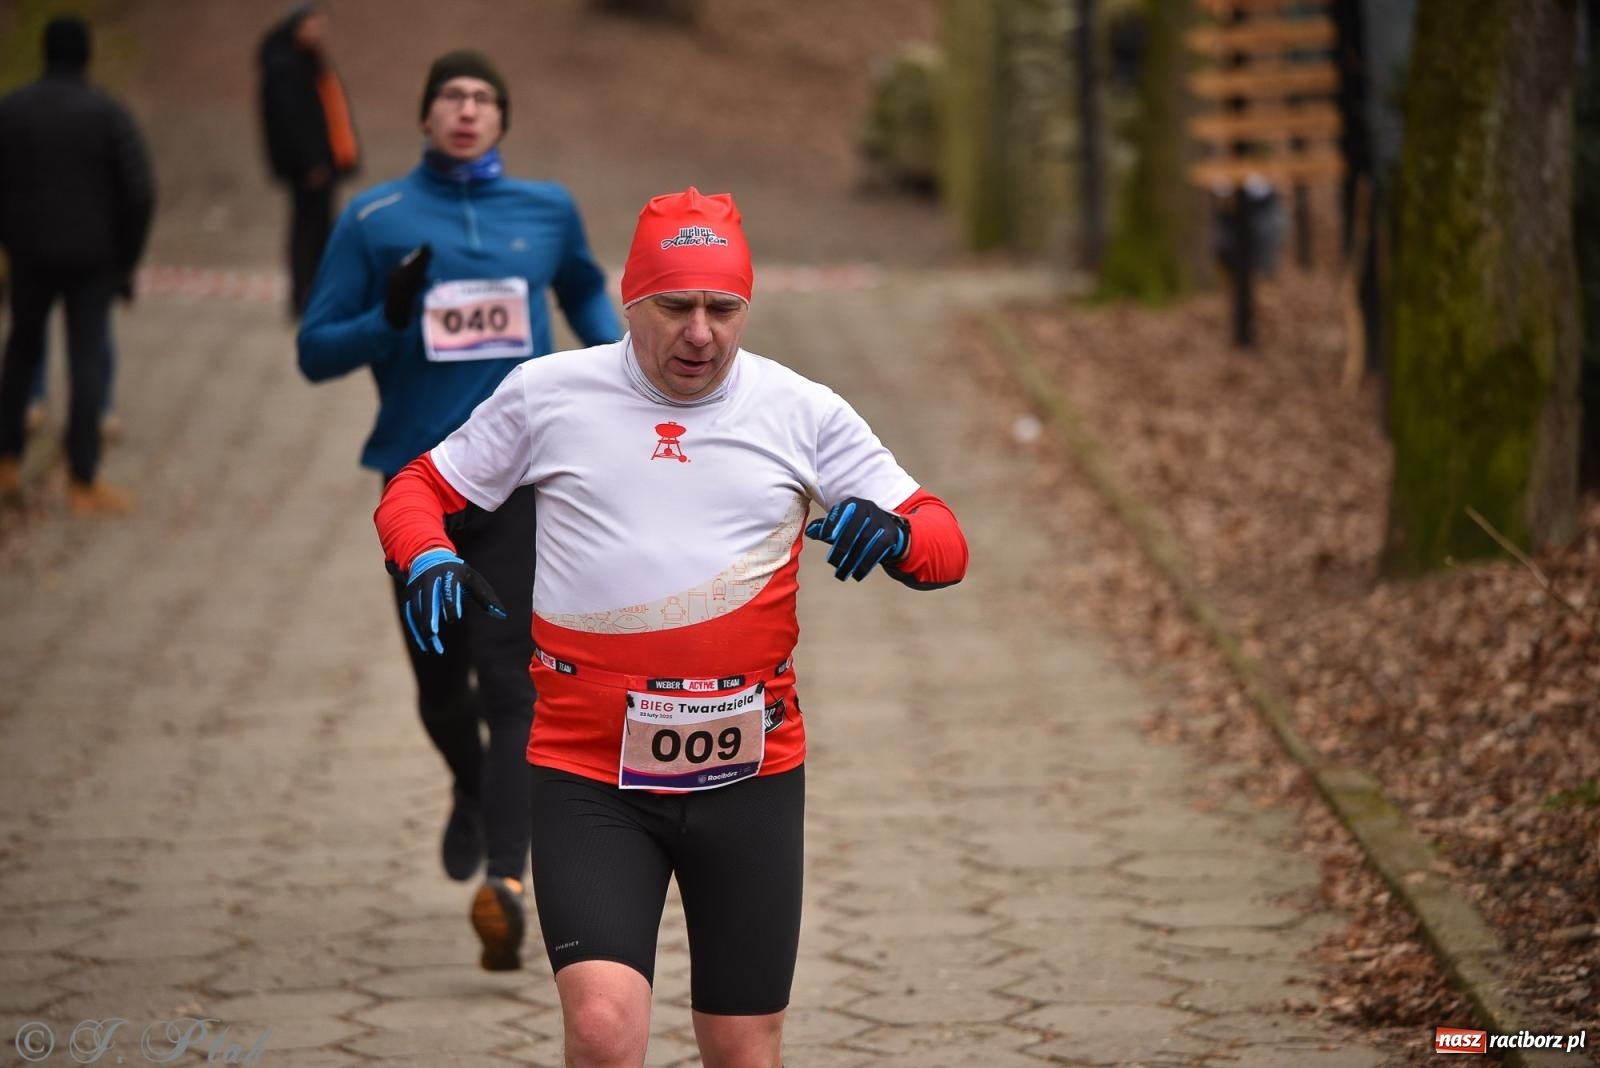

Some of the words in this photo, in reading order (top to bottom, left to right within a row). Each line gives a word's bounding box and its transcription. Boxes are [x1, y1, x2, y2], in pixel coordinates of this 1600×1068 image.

[443, 305, 509, 334] 040
[656, 680, 680, 689] WEBER
[689, 681, 715, 690] ACTIVE
[723, 678, 740, 688] TEAM
[640, 699, 674, 712] BIEG
[678, 694, 754, 713] Twardziela
[651, 727, 742, 764] 009
[707, 771, 738, 781] Racibórz
